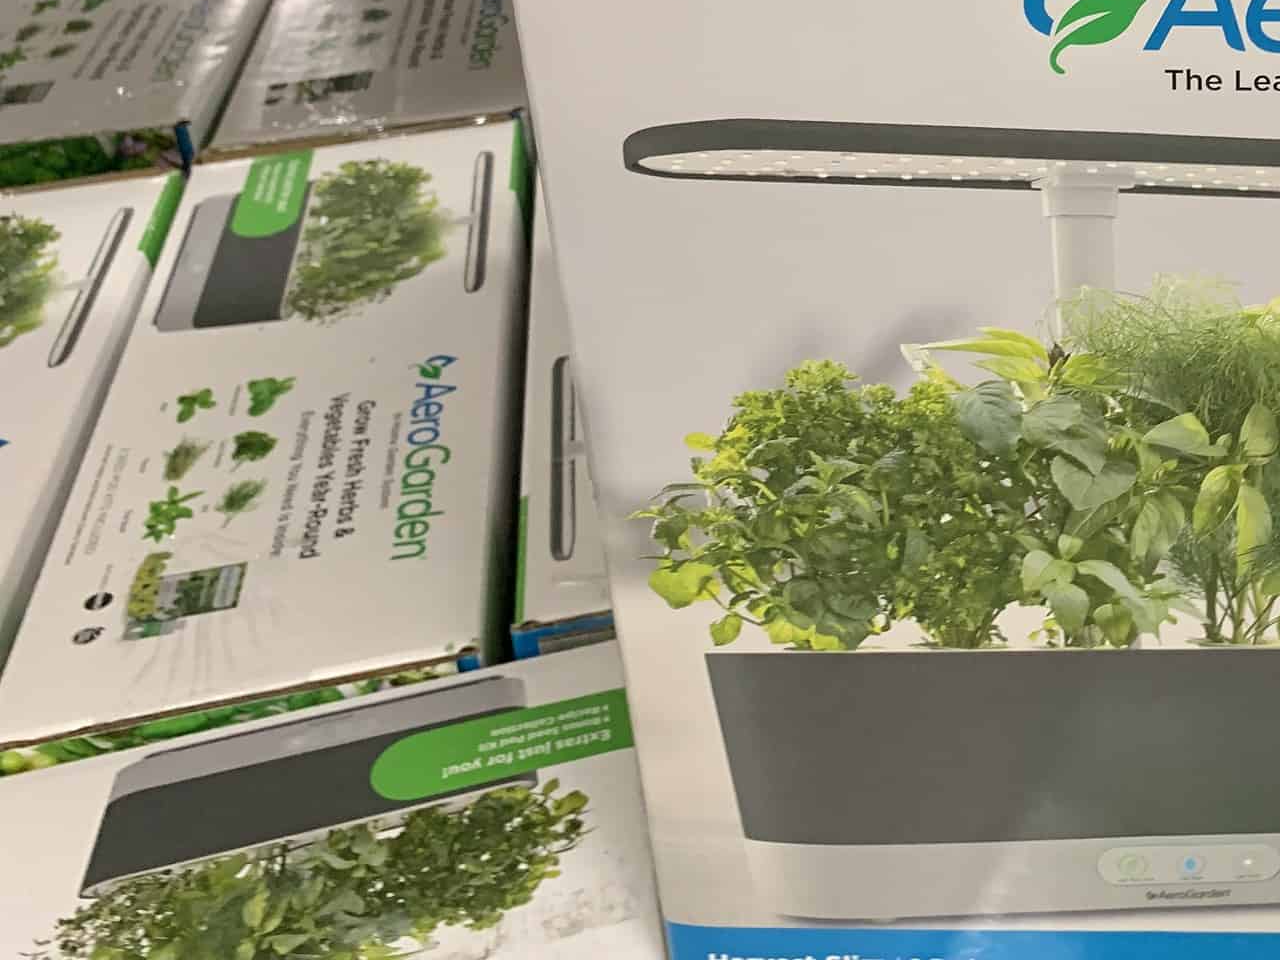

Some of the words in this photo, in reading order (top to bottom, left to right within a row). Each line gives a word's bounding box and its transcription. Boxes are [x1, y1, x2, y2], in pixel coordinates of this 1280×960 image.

[1165, 70, 1223, 94] The
[317, 391, 351, 469] Vegetables
[354, 400, 376, 435] Grow
[345, 438, 371, 478] Fresh
[390, 382, 458, 561] AeroGarden
[299, 471, 335, 560] Year-Round
[336, 479, 363, 524] Herbs
[334, 527, 354, 539] &
[517, 741, 552, 761] just
[555, 729, 612, 751] Extras
[441, 757, 483, 779] you!
[486, 751, 514, 767] for
